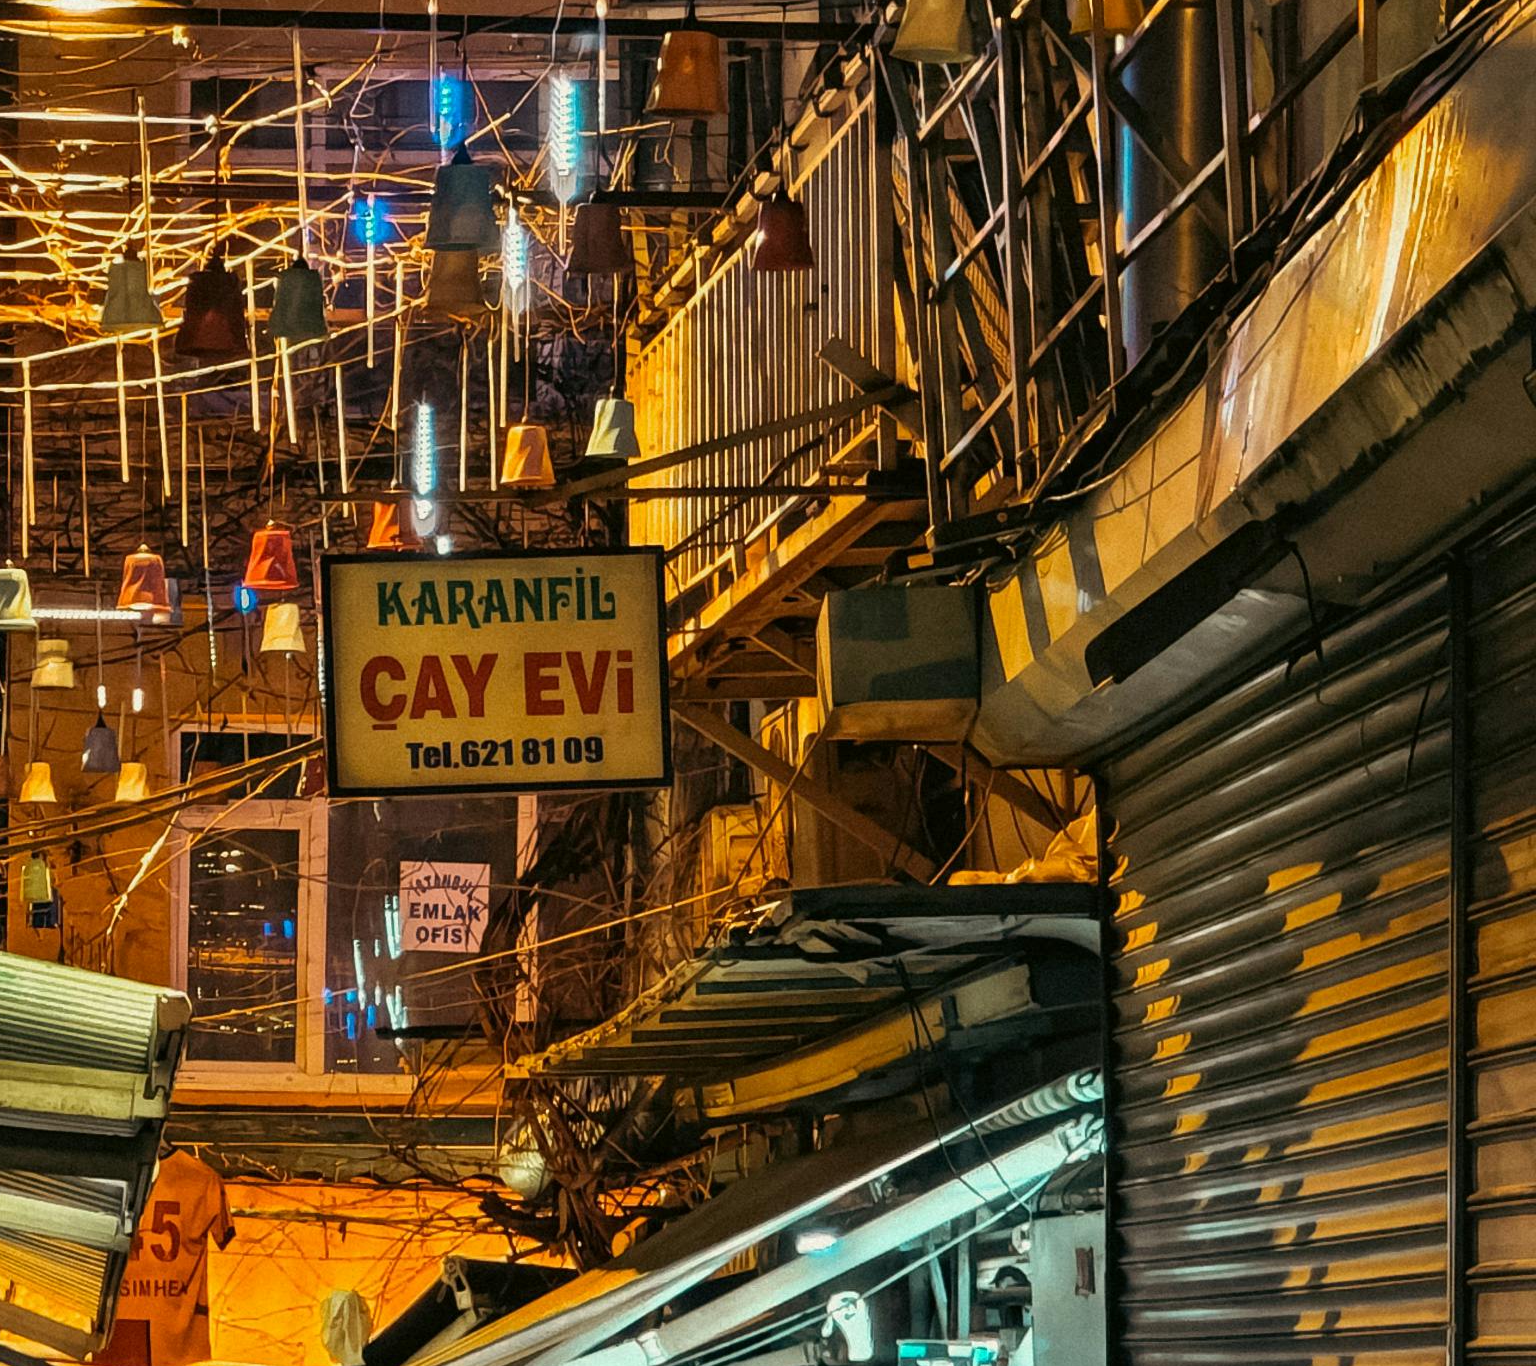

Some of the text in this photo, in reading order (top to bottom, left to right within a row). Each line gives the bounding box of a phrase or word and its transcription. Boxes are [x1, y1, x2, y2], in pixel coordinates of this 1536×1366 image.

[376, 566, 617, 629] KARANFİL
[359, 651, 499, 731] ÇAY
[405, 738, 514, 770] Tel.621
[409, 901, 481, 922] EMLAK
